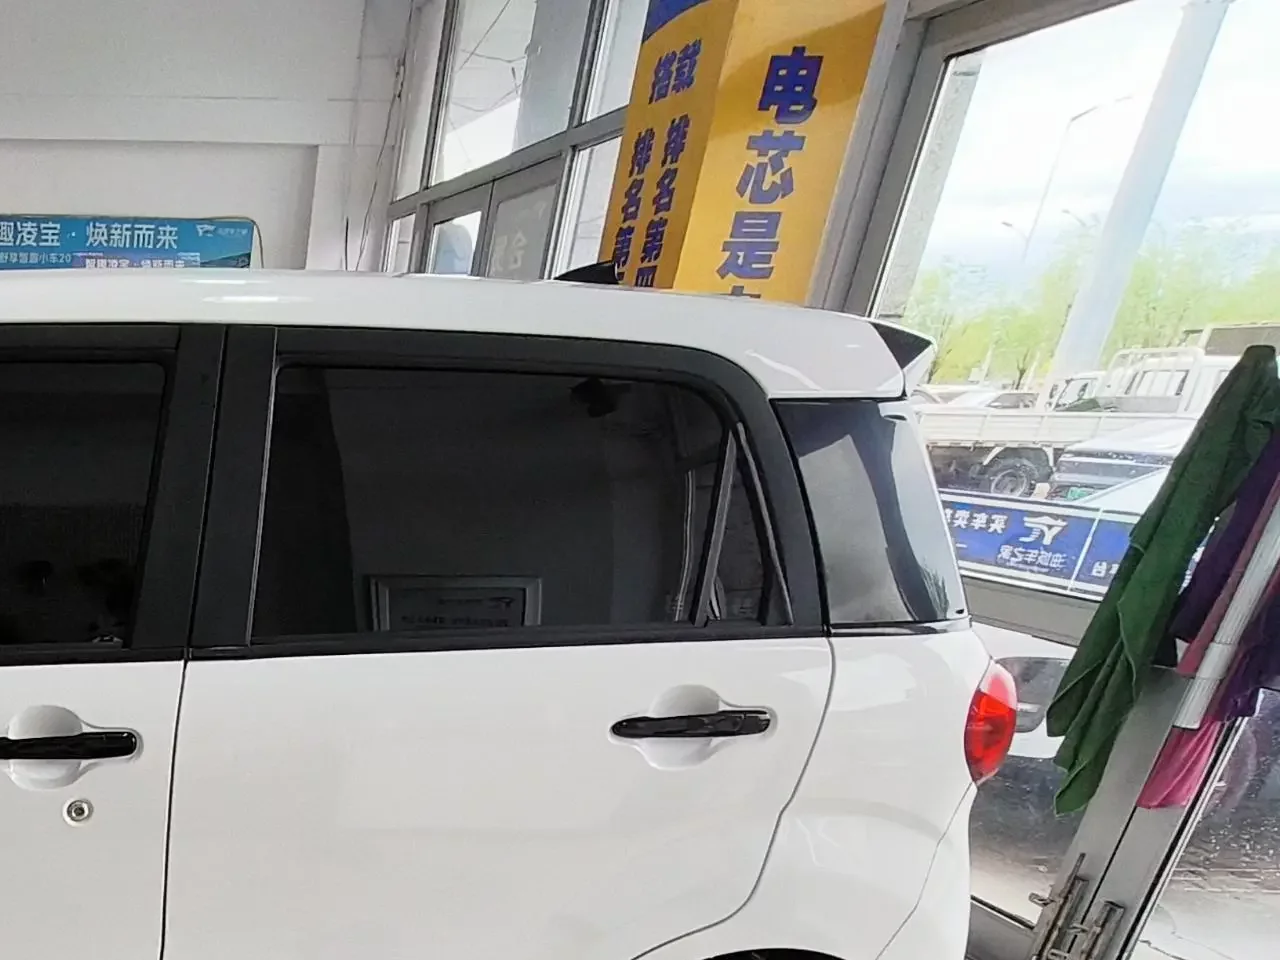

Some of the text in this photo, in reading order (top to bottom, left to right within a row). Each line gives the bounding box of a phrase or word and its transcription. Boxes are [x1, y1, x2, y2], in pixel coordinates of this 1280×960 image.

[649, 40, 702, 104] 搭载
[611, 126, 656, 283] 排名第
